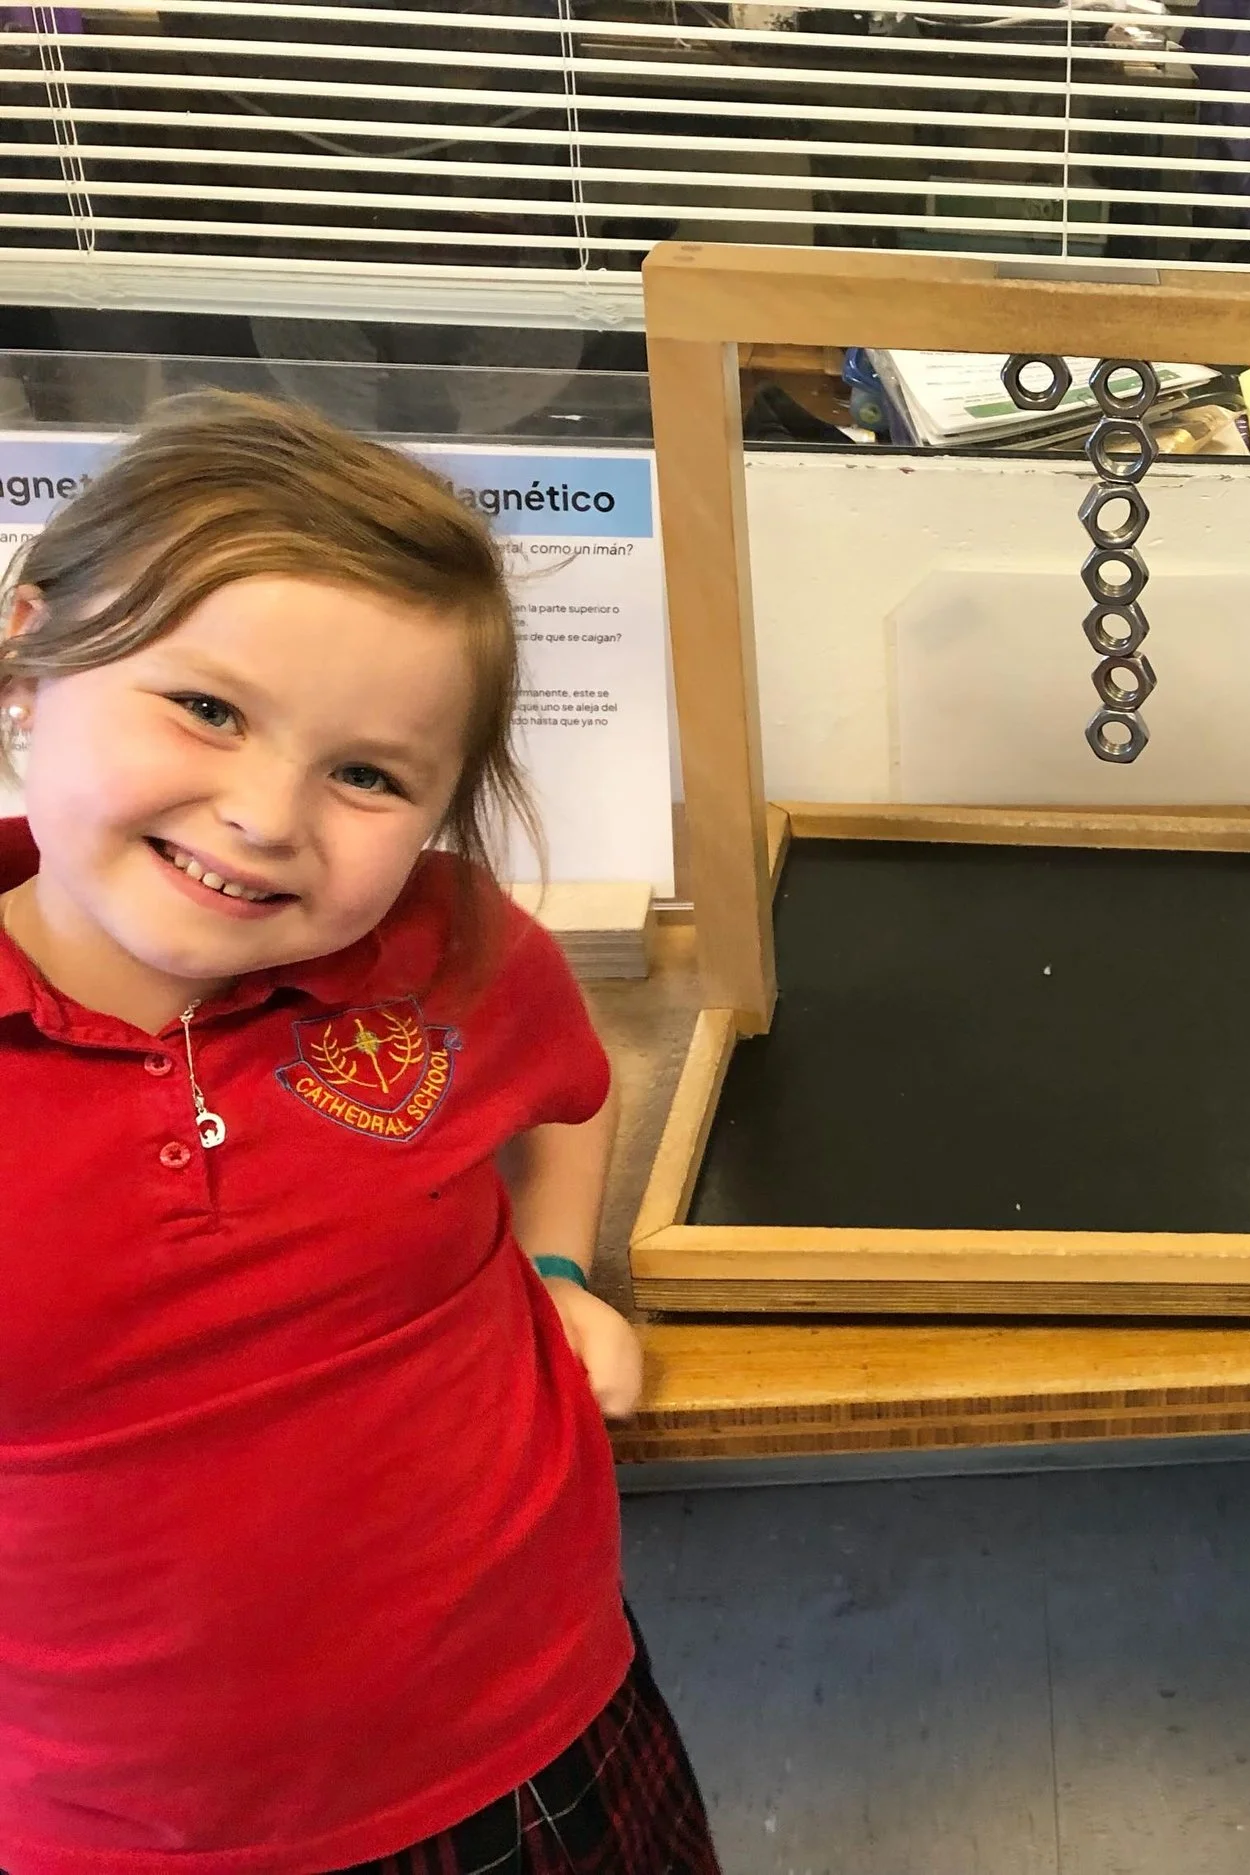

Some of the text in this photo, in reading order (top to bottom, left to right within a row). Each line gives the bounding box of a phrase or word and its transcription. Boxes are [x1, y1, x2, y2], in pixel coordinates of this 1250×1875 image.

[446, 480, 615, 516] agnético
[530, 544, 572, 554] como
[574, 544, 590, 555] un
[593, 542, 633, 556] imán?
[528, 604, 537, 613] la
[538, 605, 567, 615] parte
[568, 604, 611, 615] superior
[530, 632, 544, 642] de
[545, 634, 566, 644] que
[567, 634, 580, 642] se
[581, 632, 622, 644] caigan?
[573, 690, 596, 698] este
[597, 690, 610, 698] se
[540, 704, 561, 712] uno
[562, 704, 574, 712] se
[575, 702, 600, 713] aleja
[601, 702, 618, 712] del
[530, 716, 558, 726] hasta
[559, 718, 580, 728] que
[581, 719, 593, 728] ya
[295, 1048, 448, 1136] CATHEDRAL SCHOOL
